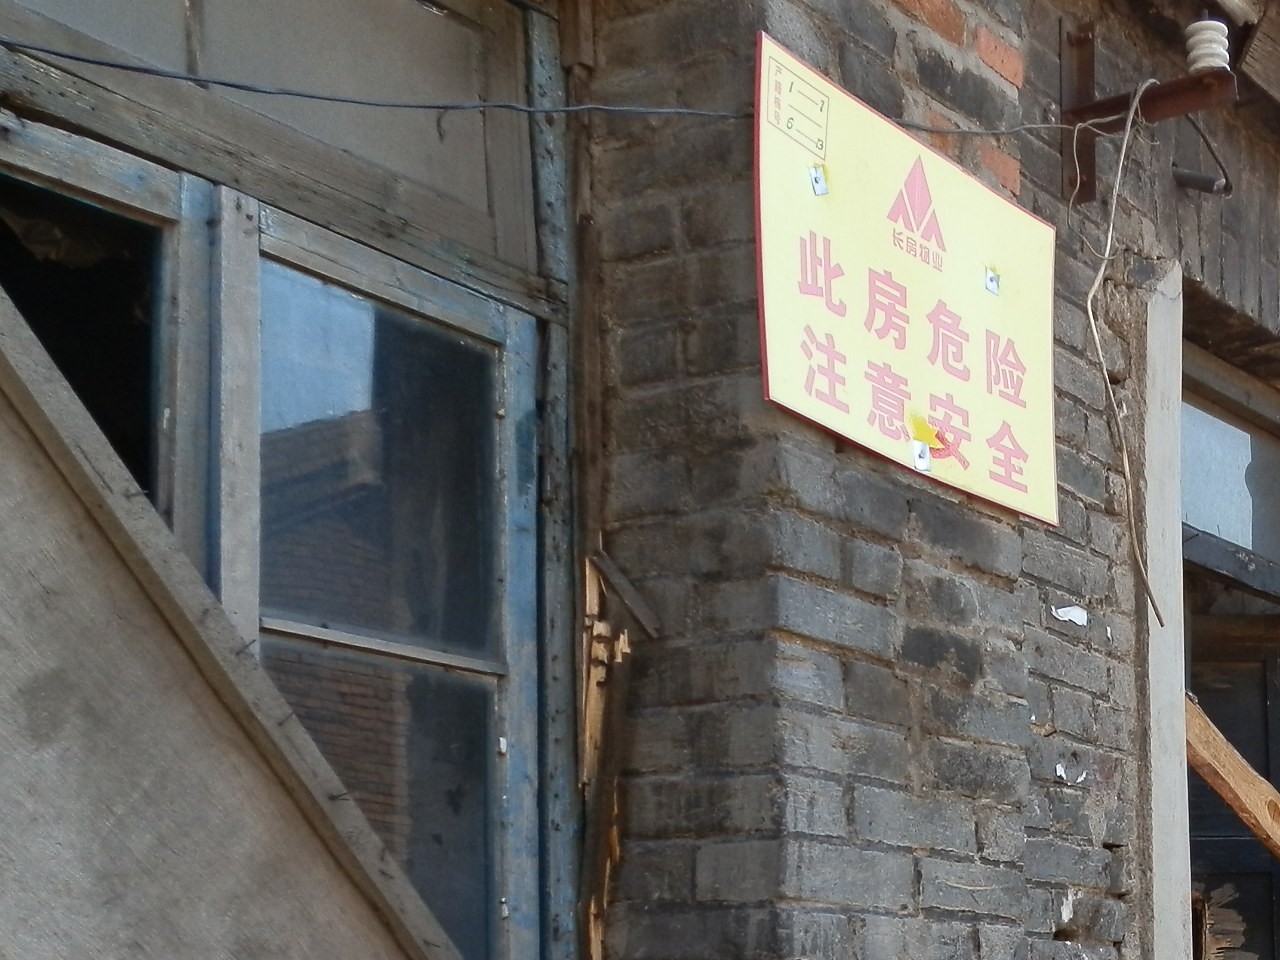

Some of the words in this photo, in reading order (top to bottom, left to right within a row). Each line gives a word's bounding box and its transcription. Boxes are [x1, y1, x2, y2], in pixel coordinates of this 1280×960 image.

[797, 229, 1027, 409] 此房危险
[892, 227, 943, 273] 长房物业
[800, 324, 1029, 495] 注意安全
